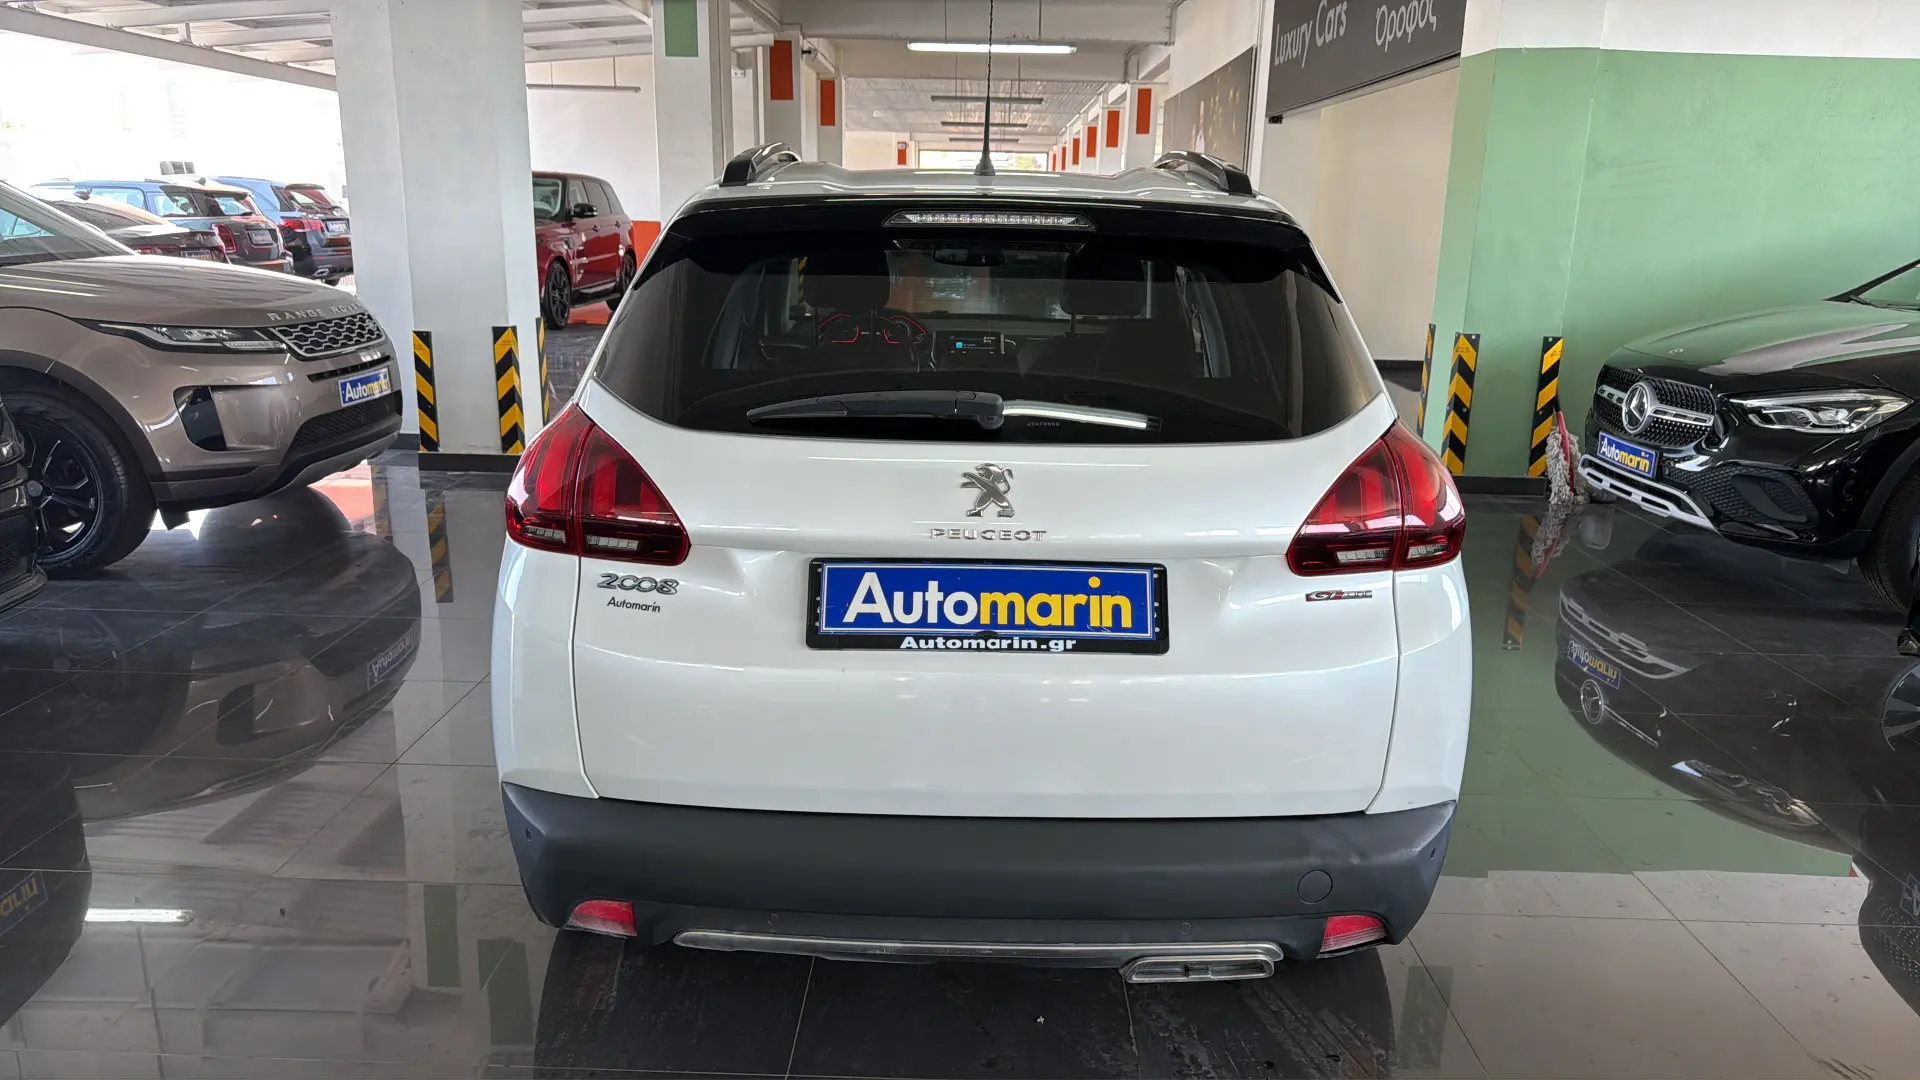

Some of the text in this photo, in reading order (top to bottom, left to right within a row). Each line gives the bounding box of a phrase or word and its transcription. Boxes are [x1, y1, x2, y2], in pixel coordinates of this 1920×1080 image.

[1274, 0, 1348, 69] Luxury Cars
[267, 308, 326, 321] RANGE
[1600, 436, 1650, 473] Automarin
[930, 528, 1047, 541] PEUGEOT
[597, 573, 680, 595] 2008
[606, 596, 661, 613] Automarin
[842, 571, 1133, 629] Automarin
[900, 636, 1077, 653] Automarin.gr
